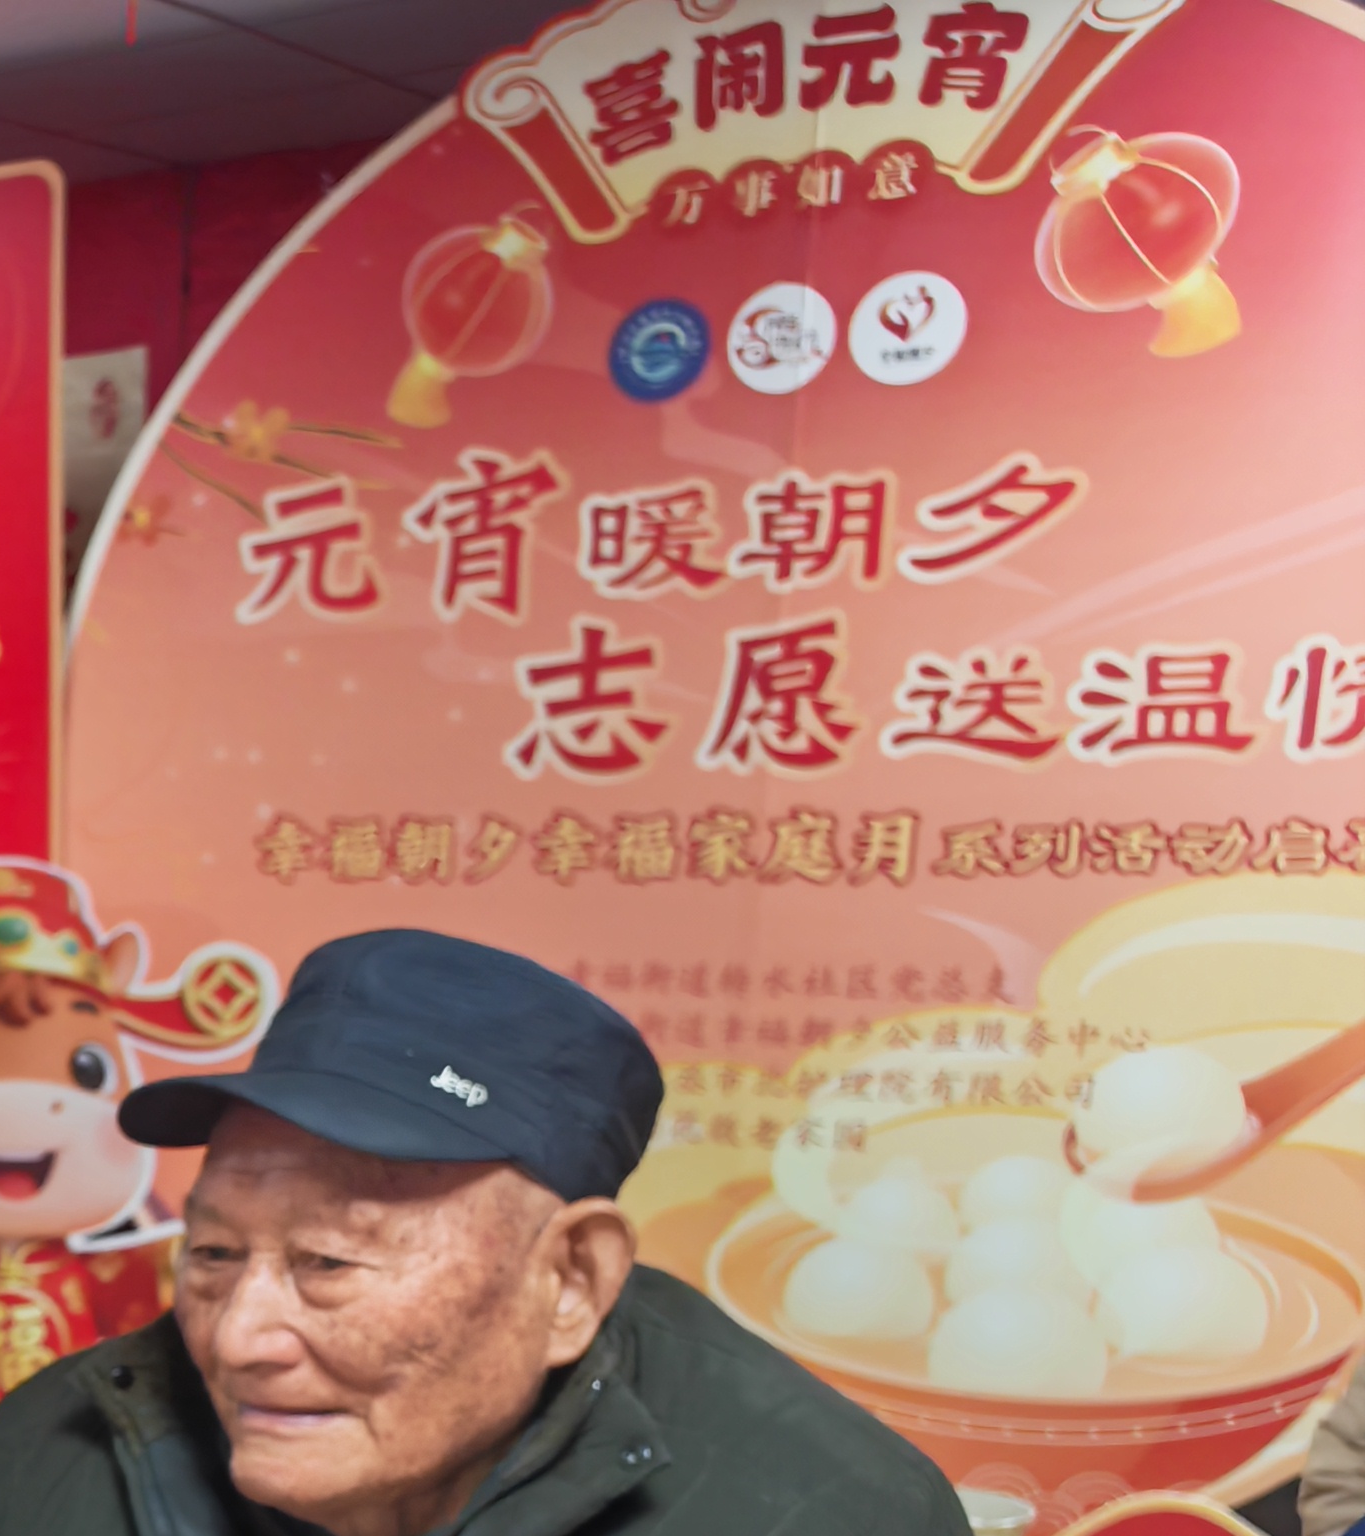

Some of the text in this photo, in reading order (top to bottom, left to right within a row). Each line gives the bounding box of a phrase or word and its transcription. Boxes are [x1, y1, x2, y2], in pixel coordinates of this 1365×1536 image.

[583, 3, 1029, 165] 喜闹元宵
[663, 150, 922, 226] 万事如意
[245, 452, 1081, 622] 元宵暖朝夕
[511, 620, 1365, 780] 志愿送温情
[430, 1065, 488, 1107] Jeep
